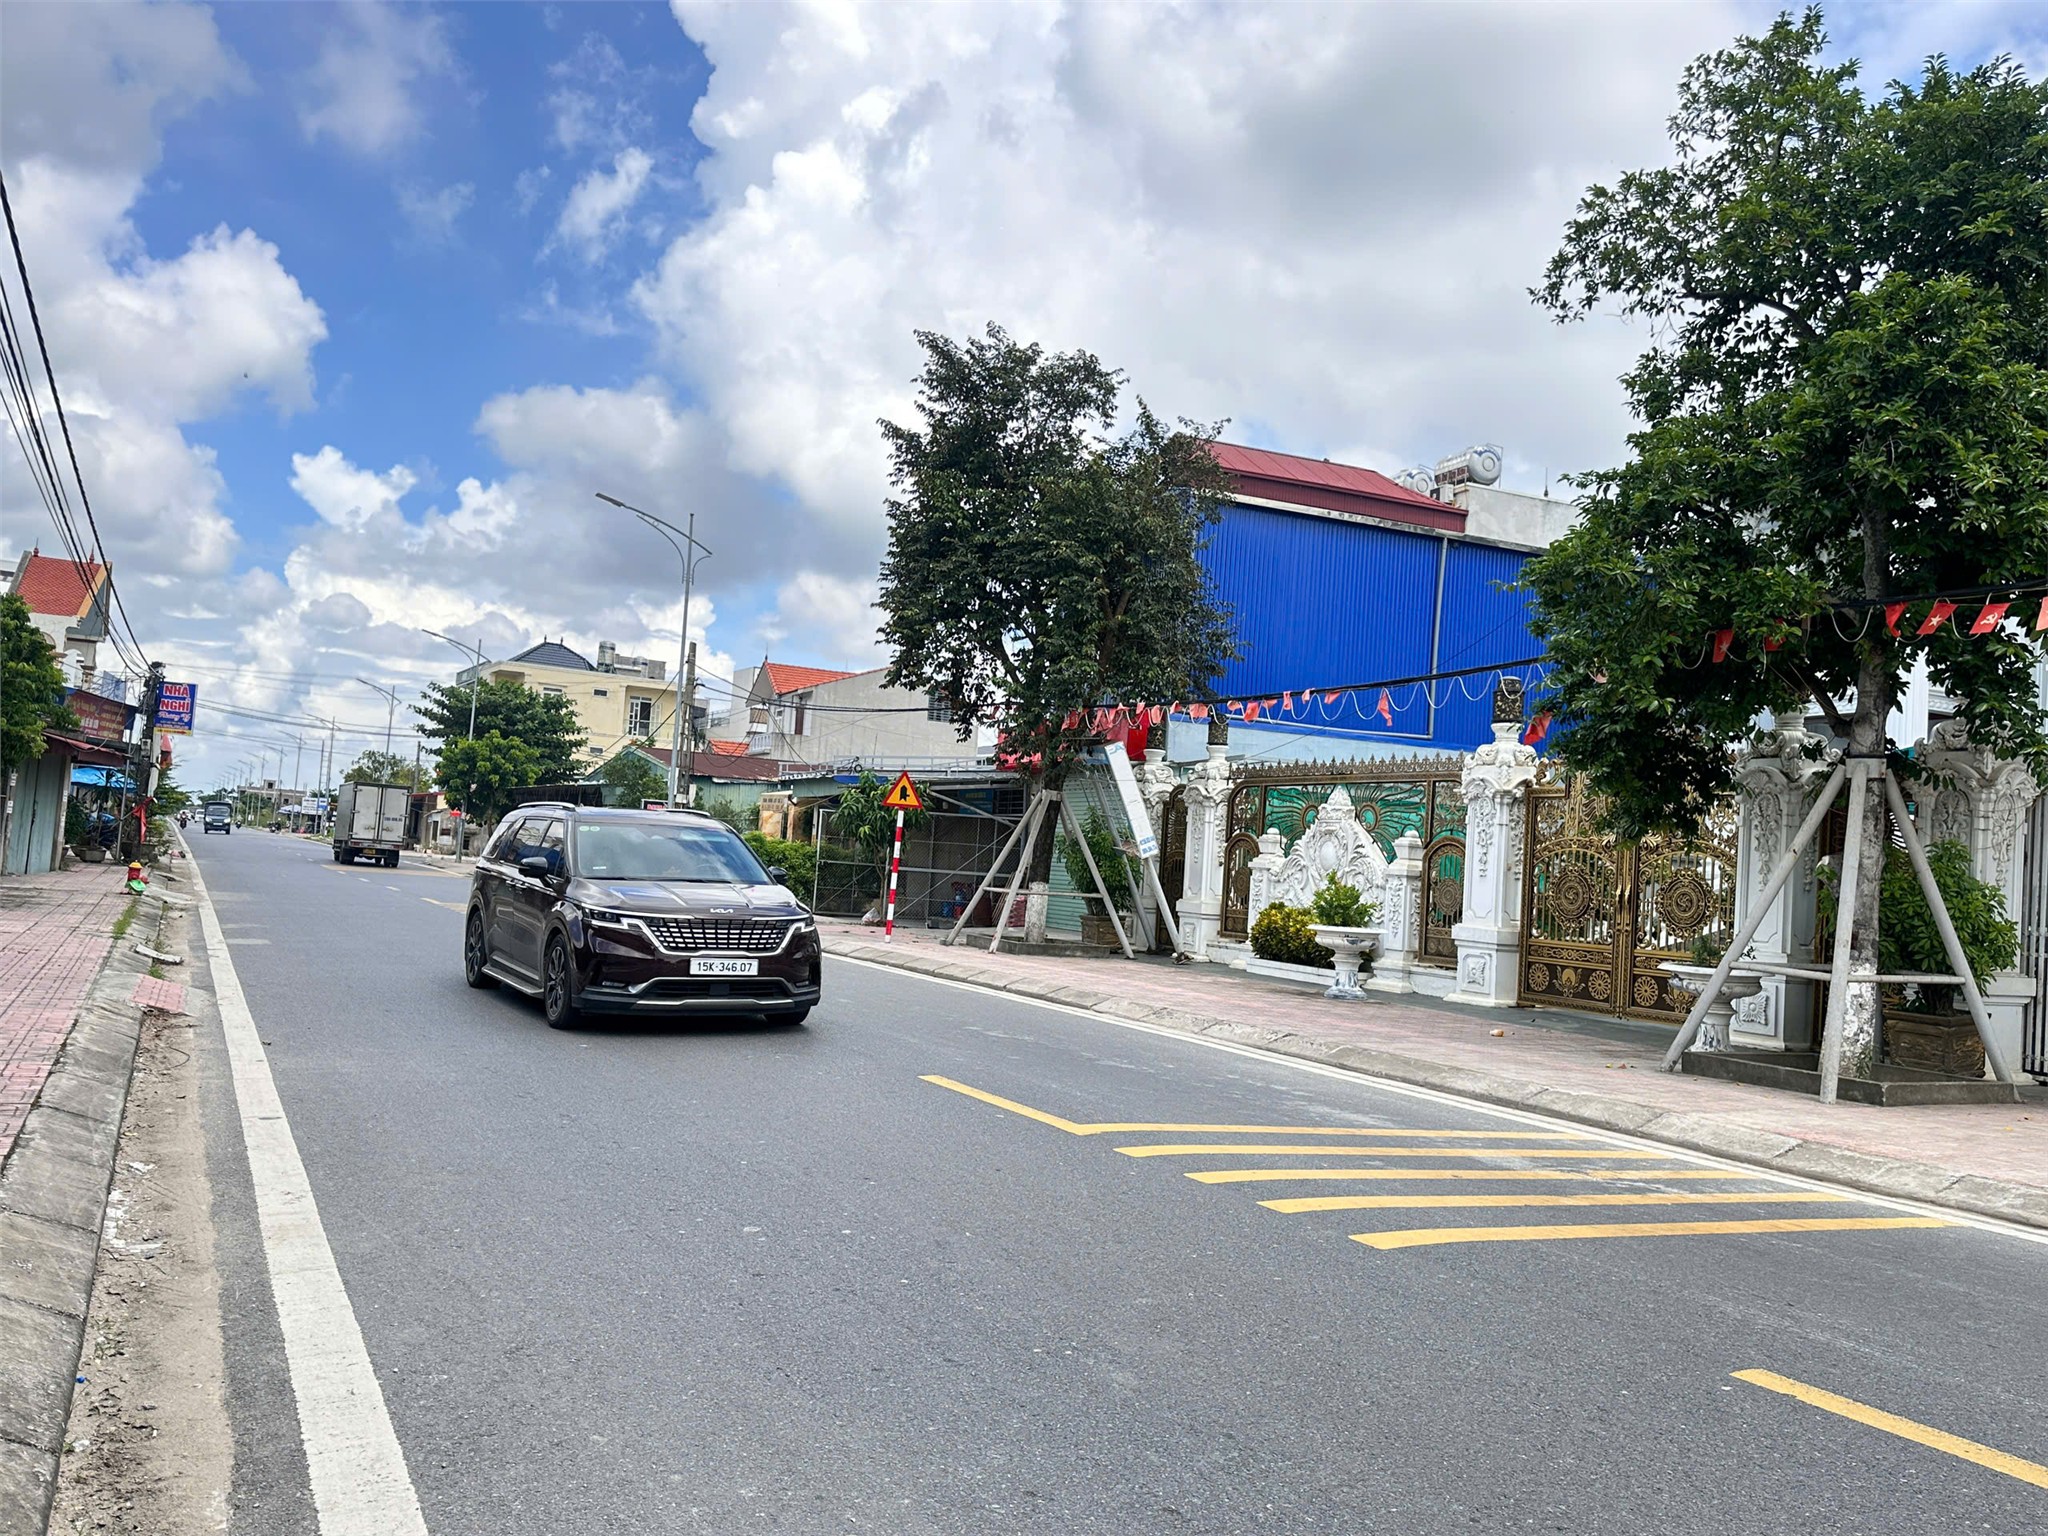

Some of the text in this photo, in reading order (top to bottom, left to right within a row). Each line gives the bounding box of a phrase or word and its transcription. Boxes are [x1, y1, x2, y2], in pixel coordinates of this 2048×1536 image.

[163, 684, 189, 697] NHÀ
[160, 698, 191, 712] NGHỈ
[697, 961, 753, 972] 15K-346.07
